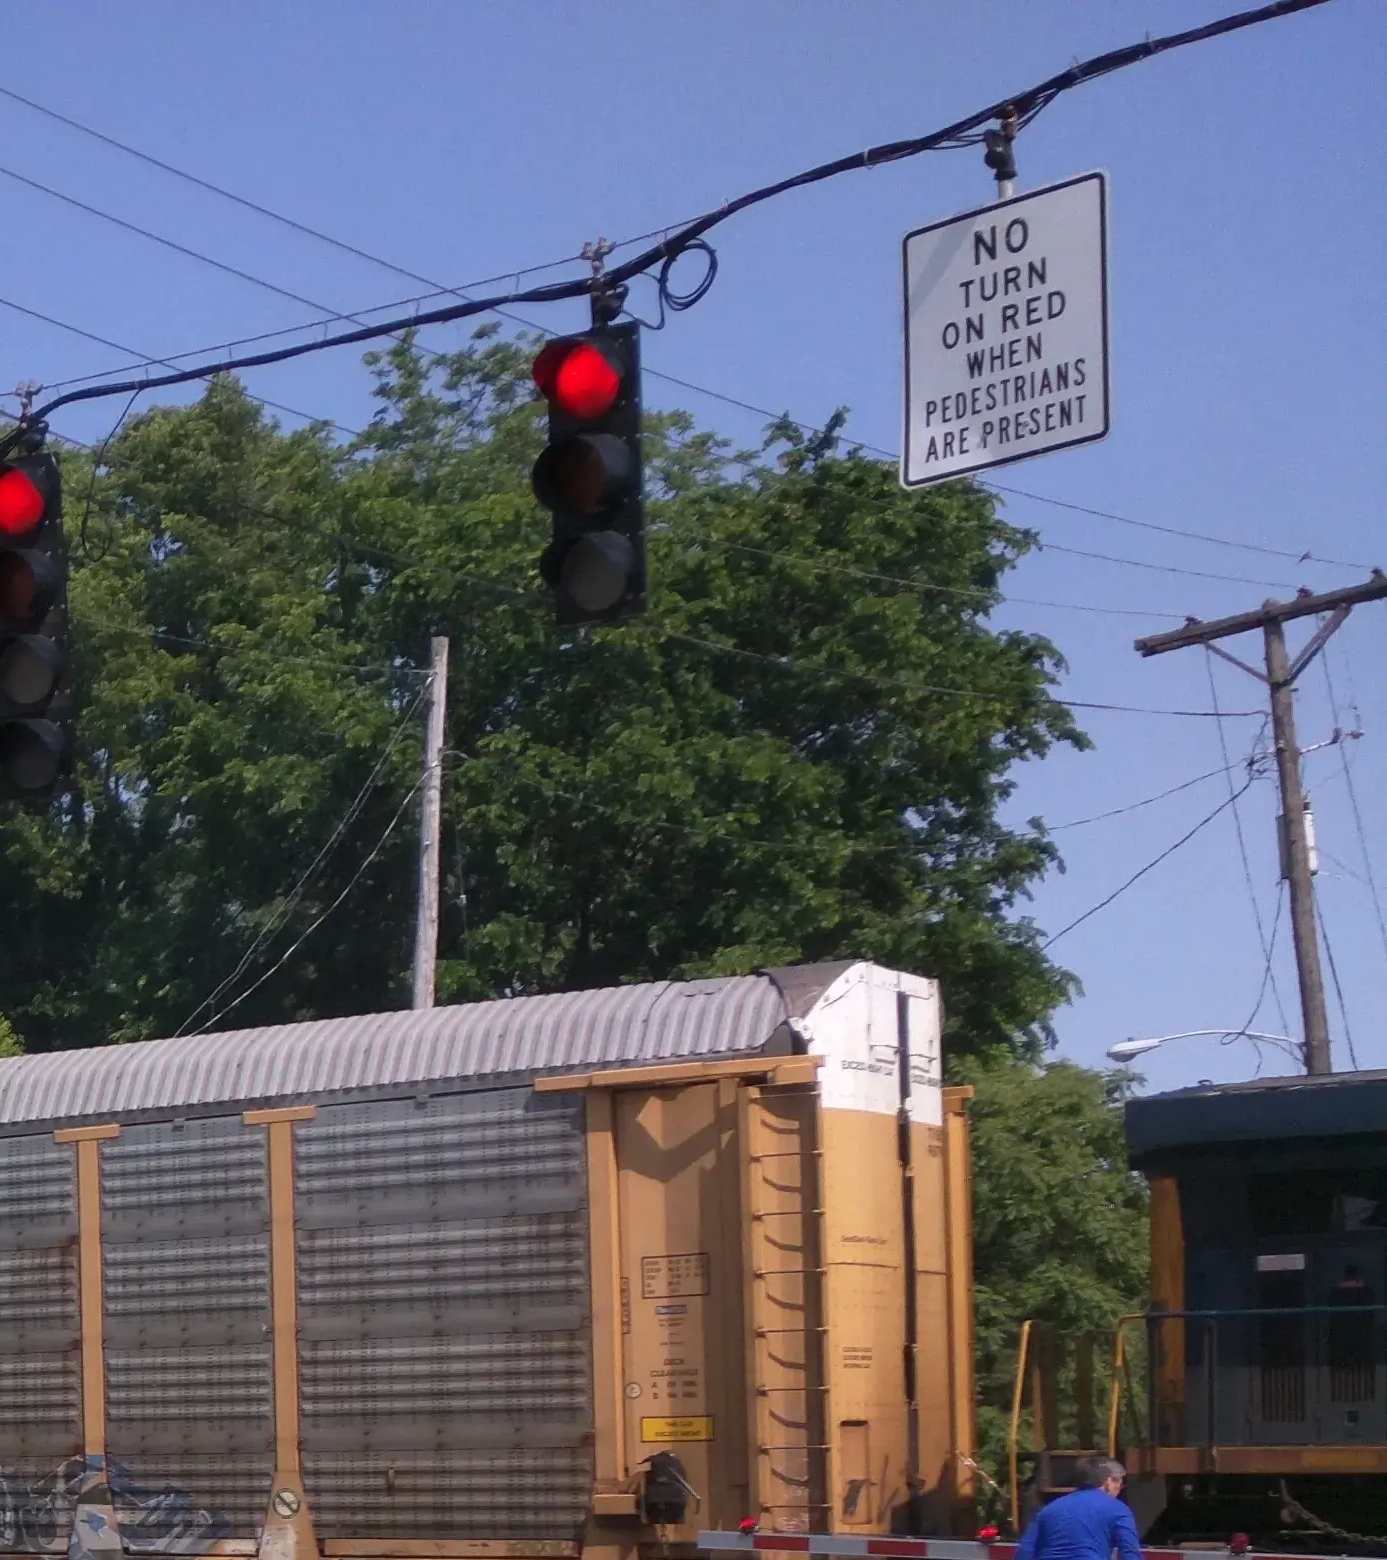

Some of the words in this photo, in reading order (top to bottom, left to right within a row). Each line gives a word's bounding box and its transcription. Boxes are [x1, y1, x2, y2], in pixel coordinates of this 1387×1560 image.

[974, 217, 1028, 265] NO
[959, 257, 1047, 308] TURN
[942, 313, 984, 349] ON
[1001, 290, 1066, 333] RED
[967, 332, 1042, 379] WHEN
[925, 357, 1086, 428] PEDESTRIANS
[925, 426, 969, 463] ARE
[983, 395, 1086, 448] PRESENT
